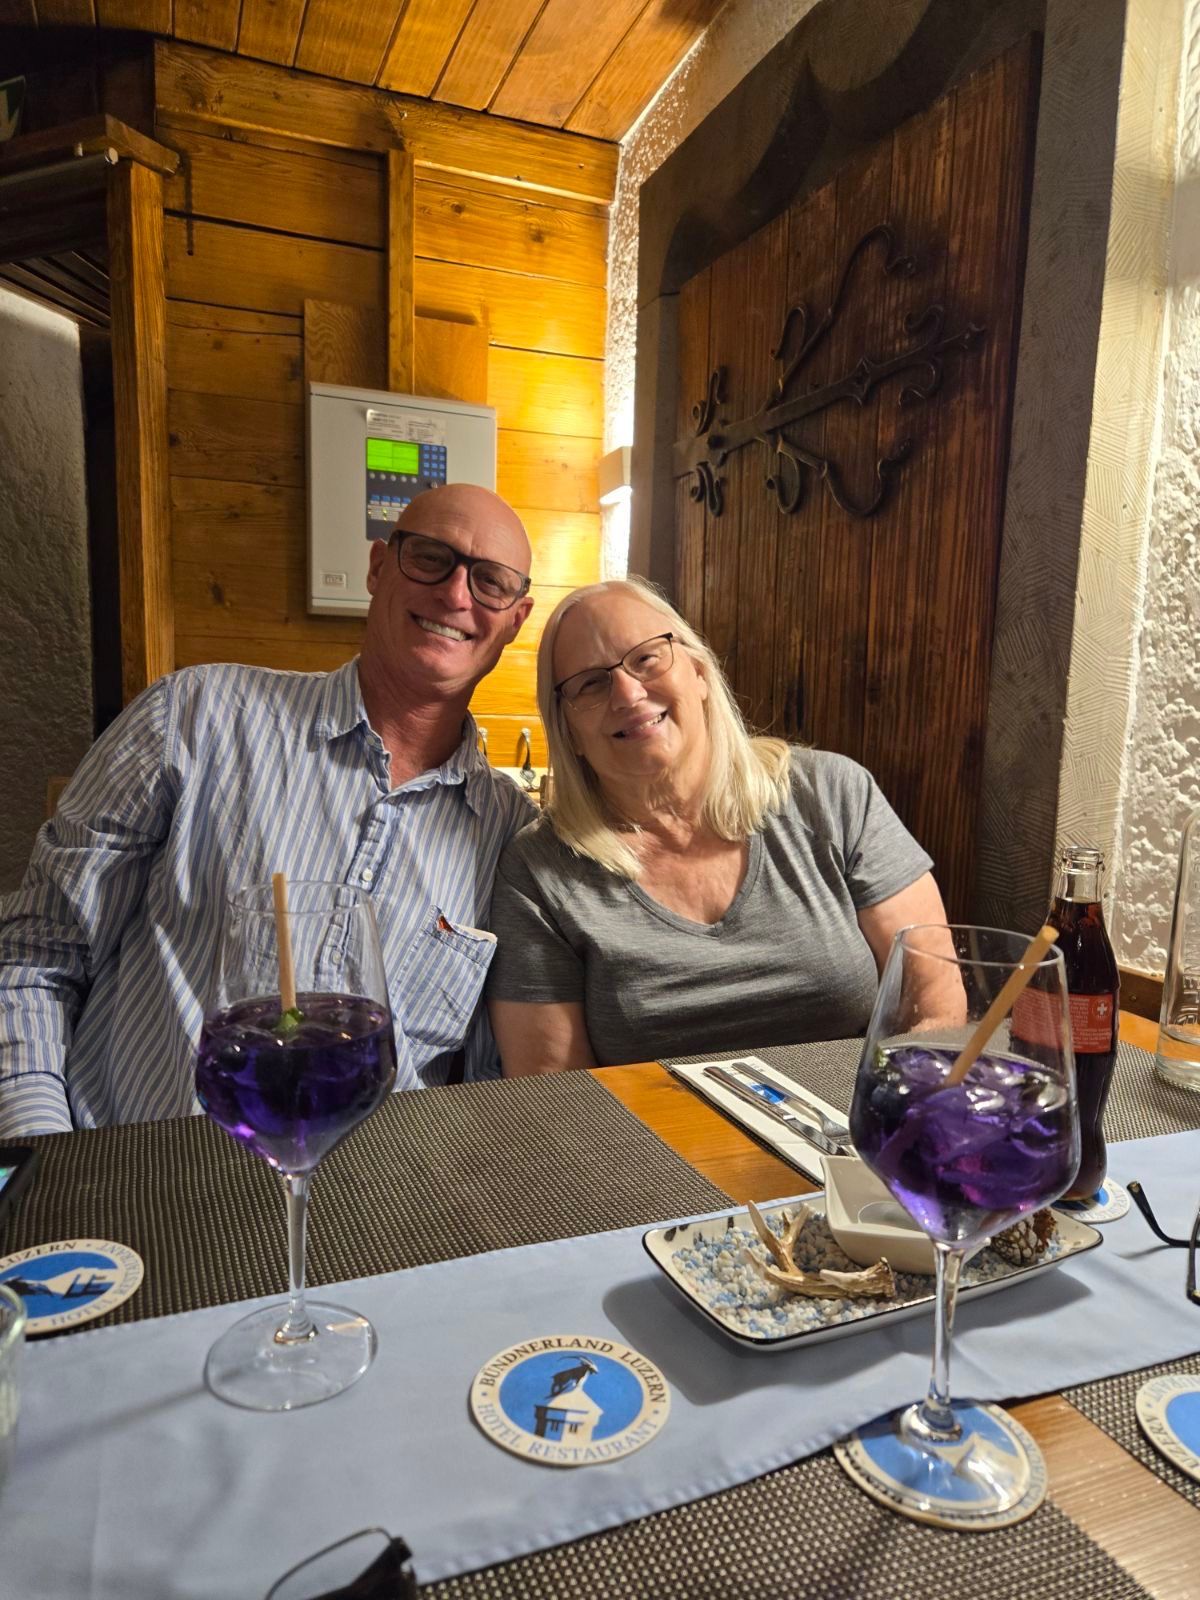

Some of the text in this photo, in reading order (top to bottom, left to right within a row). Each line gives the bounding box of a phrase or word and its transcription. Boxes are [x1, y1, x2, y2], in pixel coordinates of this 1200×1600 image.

[620, 1351, 666, 1404] LUZERN
[478, 1402, 657, 1462] HOTEL RESTAURANT
